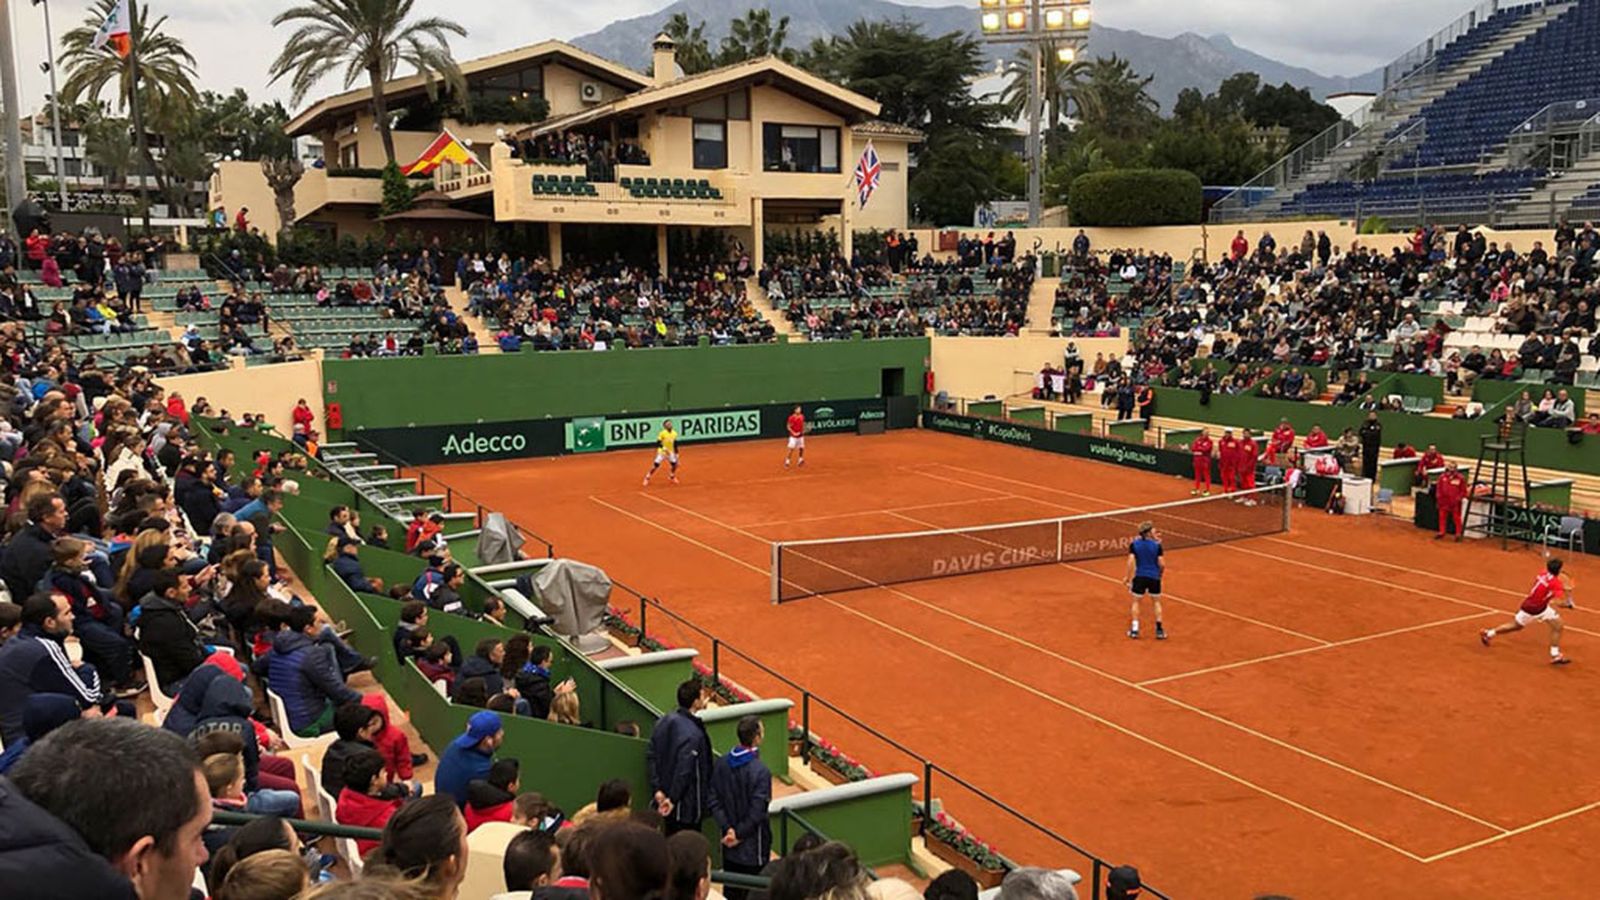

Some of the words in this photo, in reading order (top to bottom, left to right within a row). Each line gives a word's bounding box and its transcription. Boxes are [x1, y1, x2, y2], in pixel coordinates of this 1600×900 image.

[610, 422, 651, 442] BNP
[681, 414, 758, 436] PARIBAS
[441, 432, 526, 456] Adecco
[1090, 443, 1123, 462] vueling
[1123, 450, 1157, 464] AIRLINES
[1504, 508, 1559, 528] DAVIS
[932, 552, 995, 575] DAVIS
[1000, 546, 1038, 565] CUP
[1063, 540, 1097, 554] BNP
